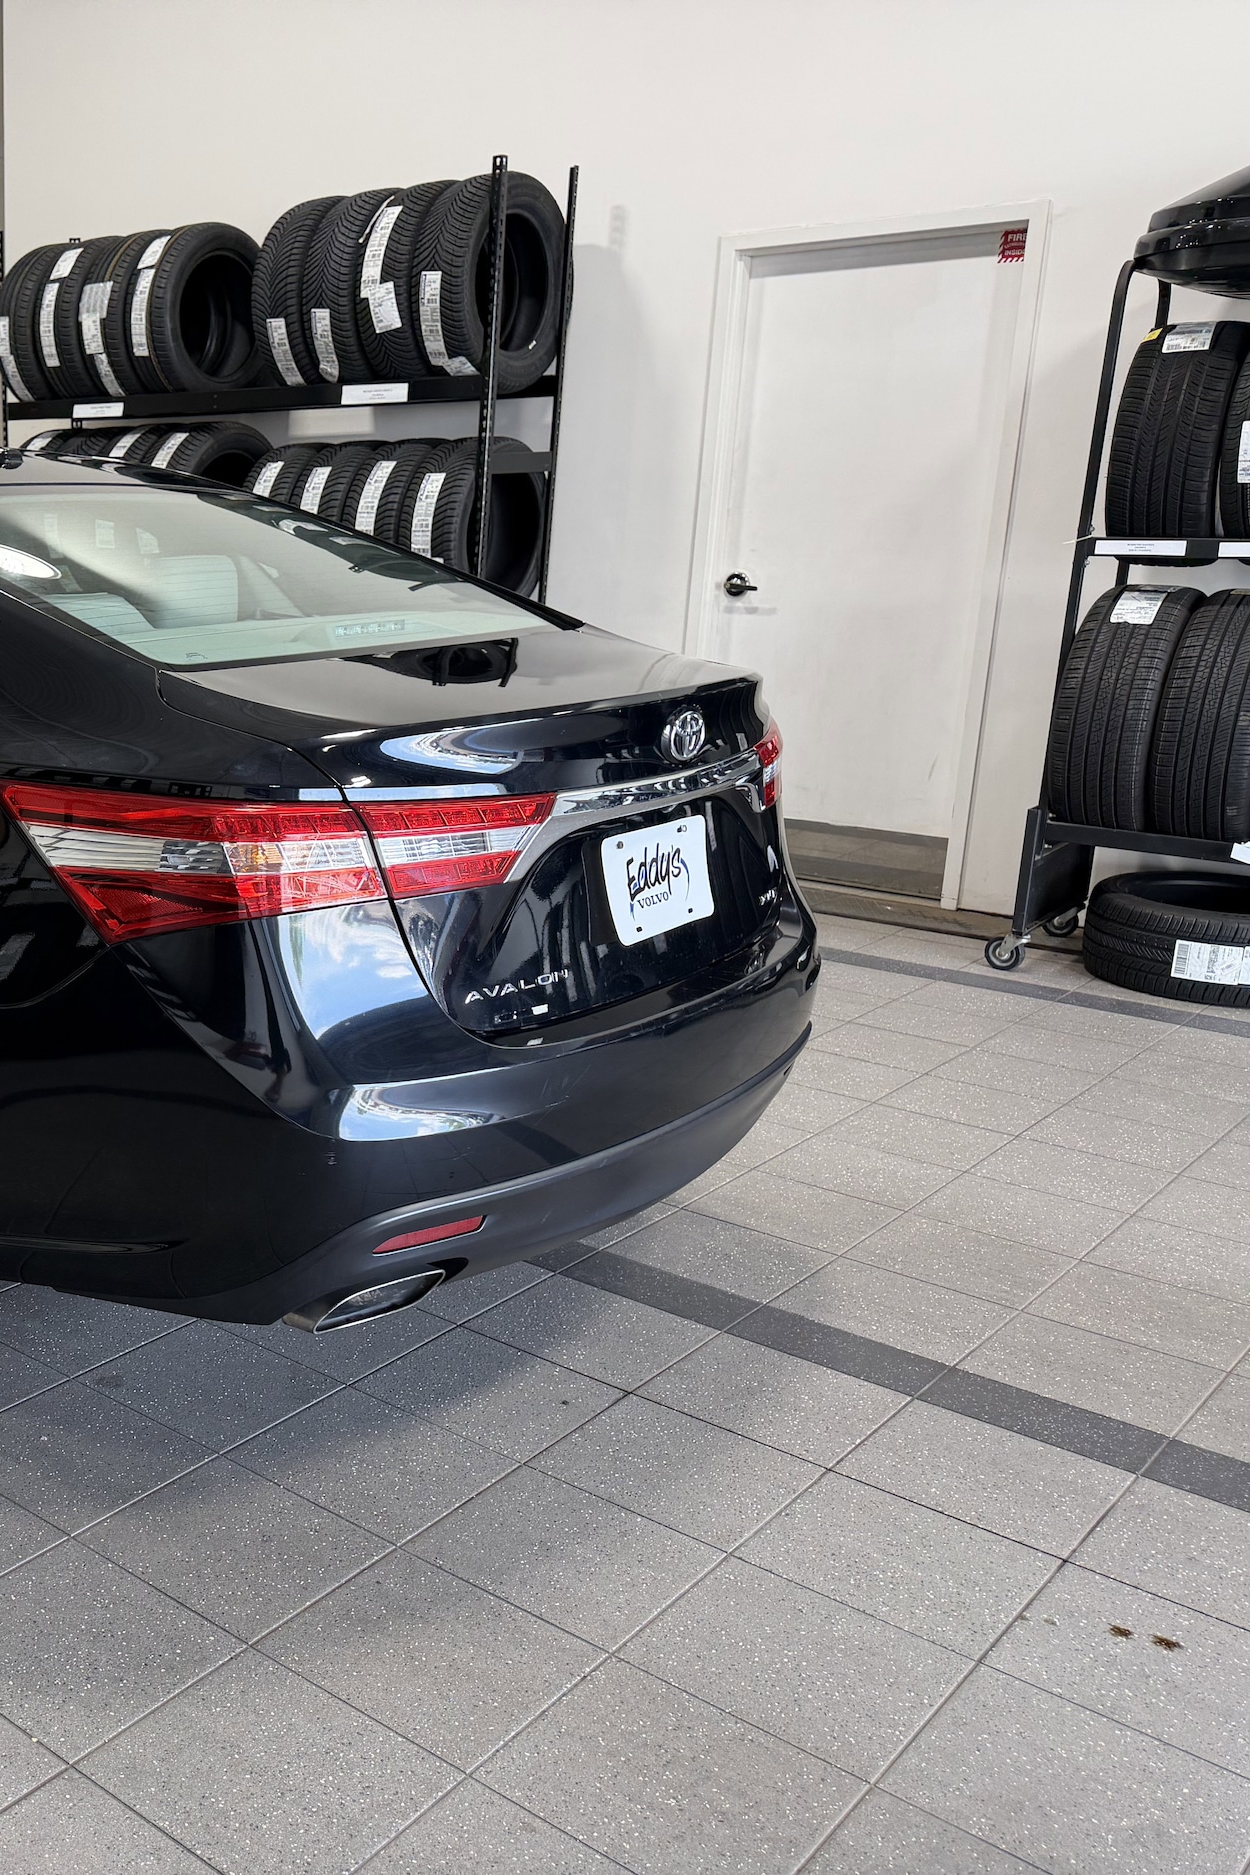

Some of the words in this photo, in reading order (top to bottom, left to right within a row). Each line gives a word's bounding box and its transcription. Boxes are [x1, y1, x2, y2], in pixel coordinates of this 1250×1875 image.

[626, 842, 682, 903] Eddy's
[636, 891, 670, 909] VOLVO
[464, 968, 569, 1005] AVALON
